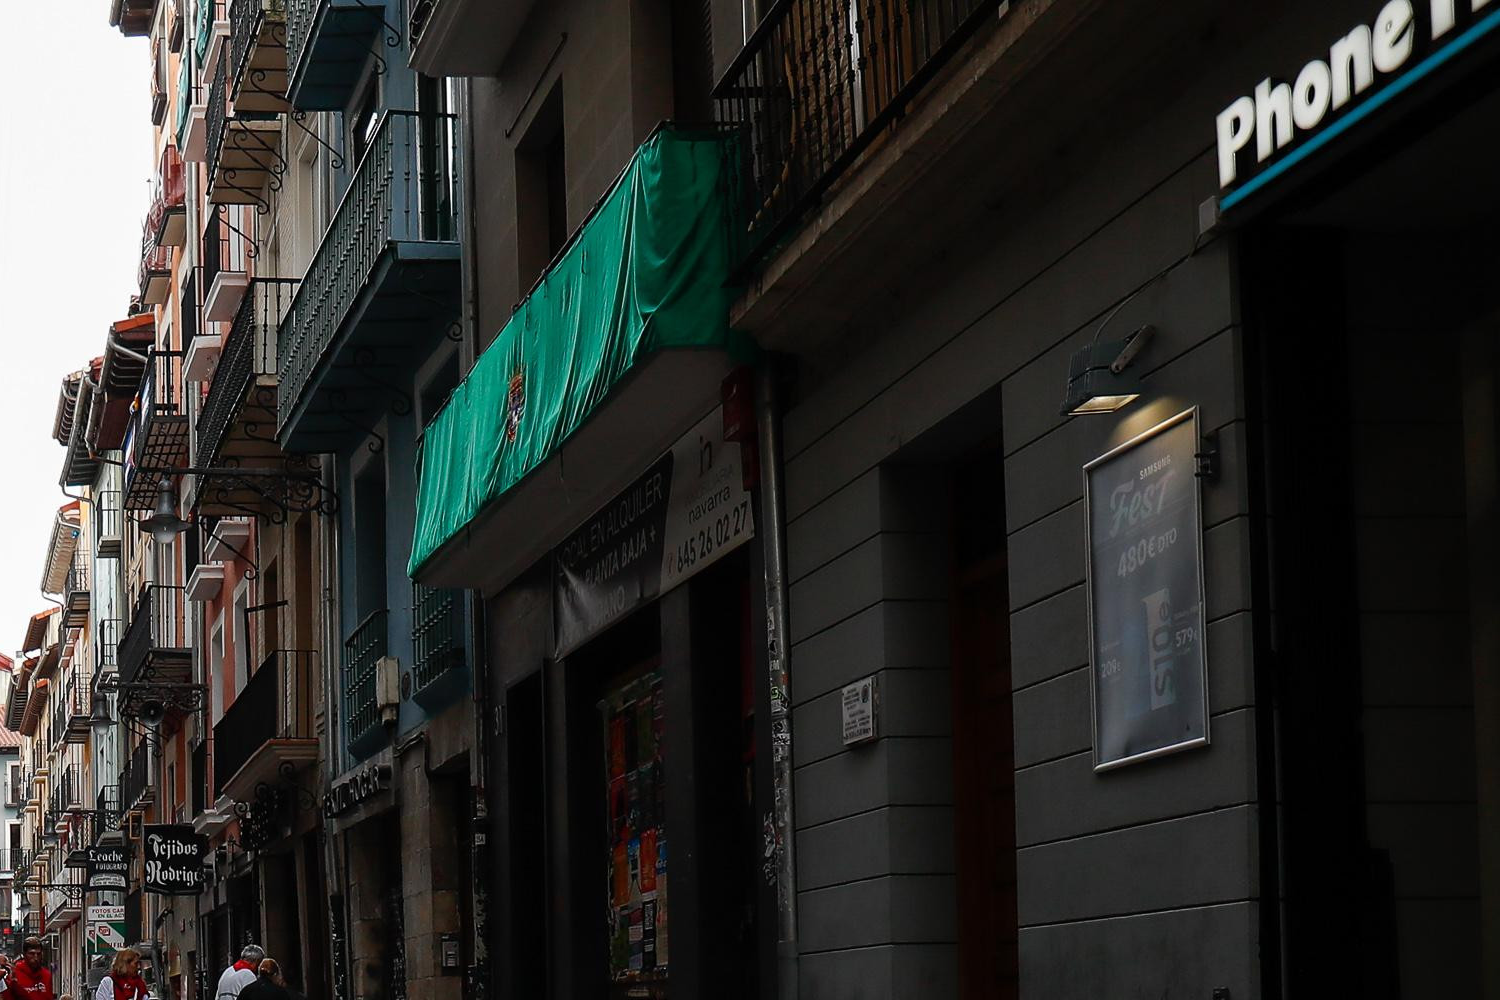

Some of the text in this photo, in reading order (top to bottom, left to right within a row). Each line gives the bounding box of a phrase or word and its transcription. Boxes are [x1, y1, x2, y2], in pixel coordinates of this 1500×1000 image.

[1216, 0, 1414, 189] Phone
[1139, 455, 1172, 480] SAMSUNG
[607, 472, 663, 536] ALQUILER
[688, 486, 731, 525] navarra
[621, 531, 648, 567] BAJA
[677, 501, 748, 573] 645 26 02 27
[89, 850, 123, 862] Leache
[147, 833, 198, 860] Tejidos
